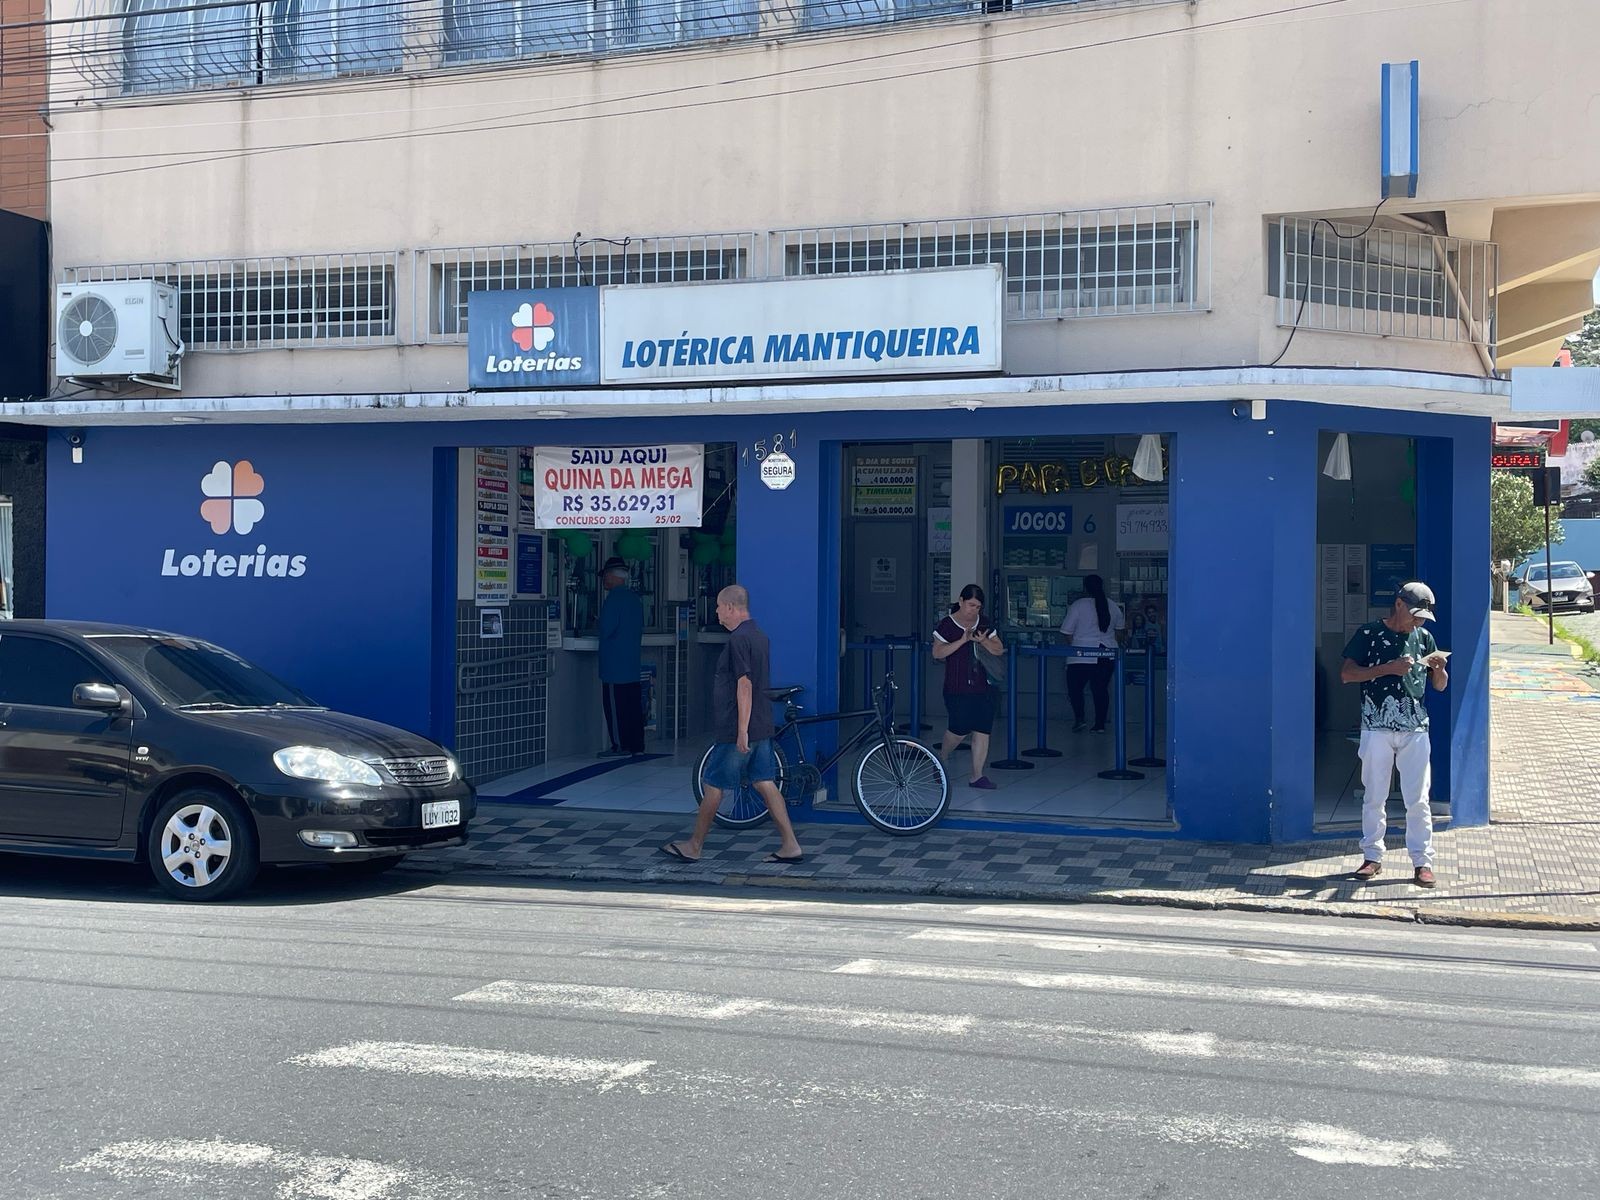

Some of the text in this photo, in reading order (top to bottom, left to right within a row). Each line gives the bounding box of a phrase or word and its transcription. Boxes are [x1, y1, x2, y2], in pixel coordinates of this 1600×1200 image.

[125, 297, 144, 305] ELGIN
[621, 325, 980, 369] LOTÉRICA MANTIQUEIRA
[485, 352, 583, 374] Loterias
[571, 448, 667, 465] SAIU AQUI
[891, 457, 915, 465] SORTE
[545, 468, 605, 492] QUINA
[610, 468, 636, 489] DA
[641, 466, 693, 488] MEGA
[763, 466, 793, 476] SEGURA
[857, 467, 914, 475] ACUMULADA
[866, 487, 912, 495] TIMEMANIA
[563, 494, 675, 514] R$ 35.629,31
[556, 515, 681, 525] CONCURSO 2833 25/02
[1011, 511, 1066, 531] JOGOS
[1083, 514, 1097, 533] 6
[161, 544, 308, 578] Loterias
[424, 809, 458, 826] LUY 1032
